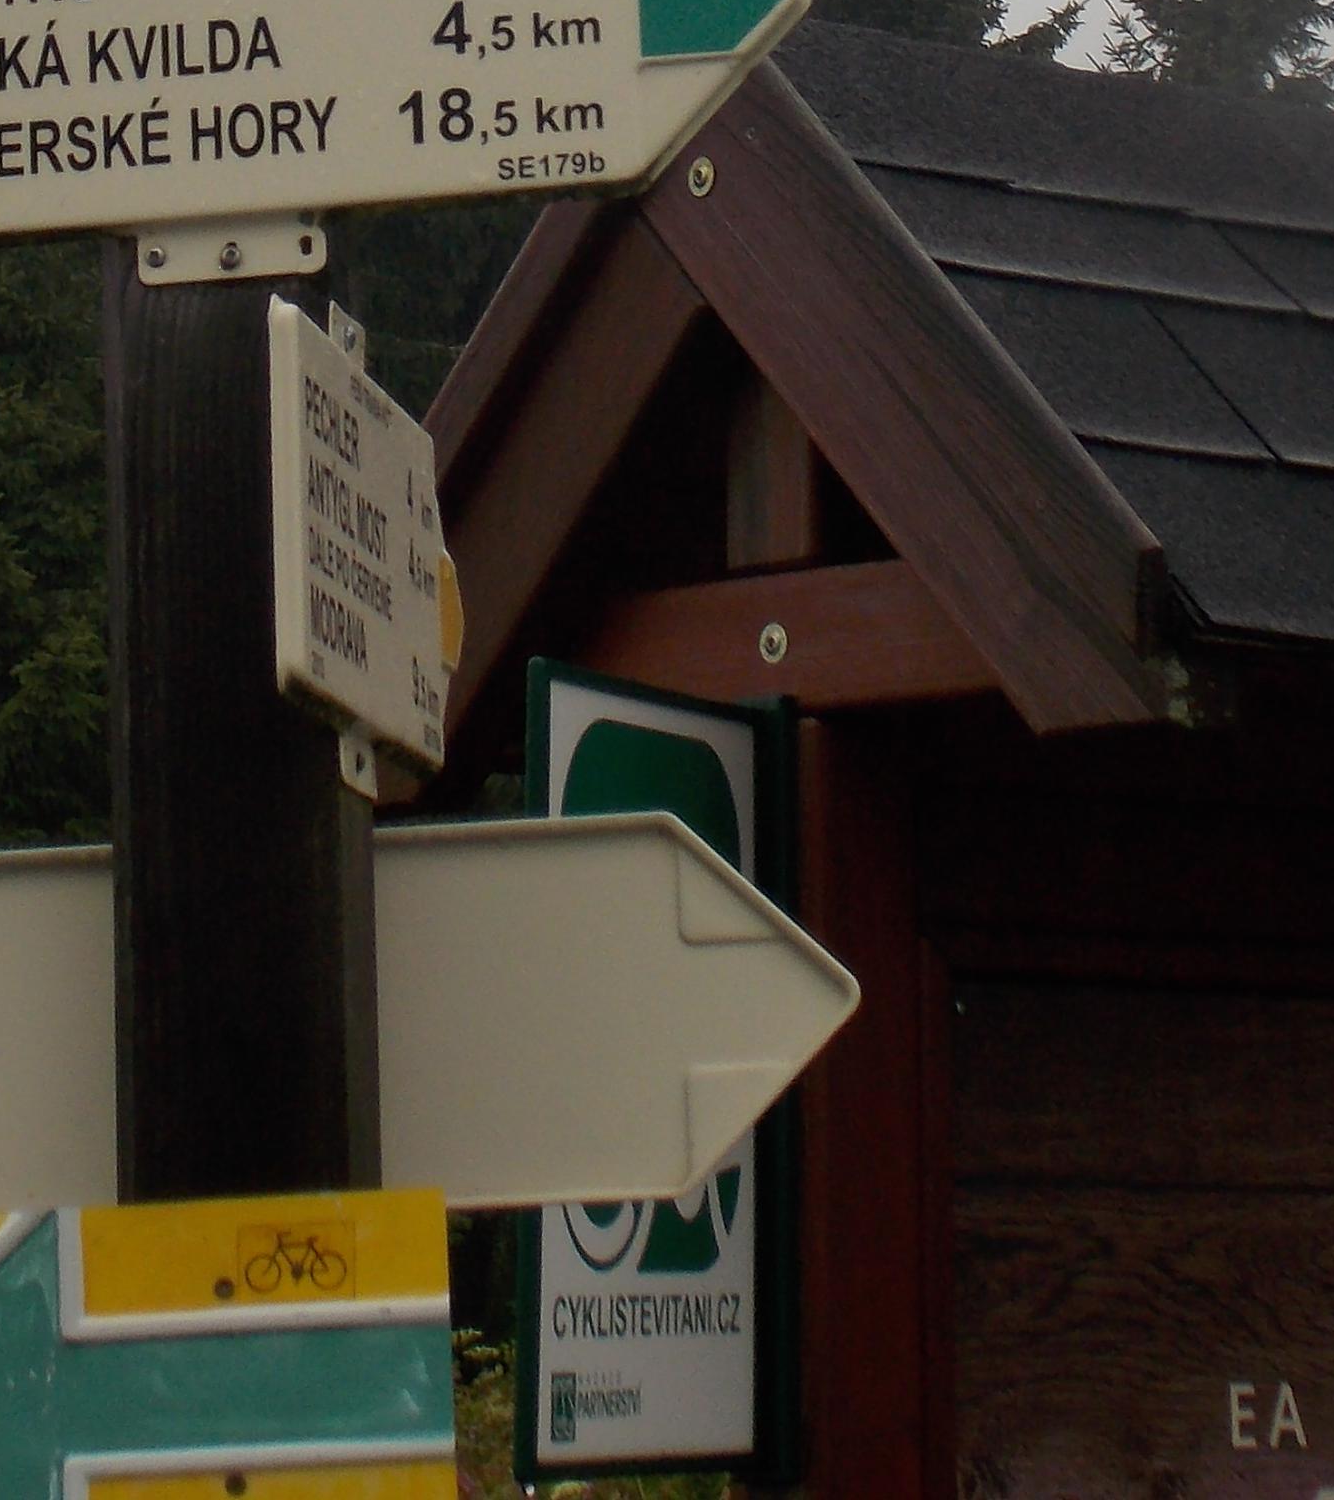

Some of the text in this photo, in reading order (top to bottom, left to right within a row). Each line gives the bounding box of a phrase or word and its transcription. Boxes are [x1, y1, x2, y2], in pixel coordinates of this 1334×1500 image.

[88, 17, 281, 83] KVILDA
[432, 1, 515, 59] 4,5
[533, 12, 600, 48] km
[191, 96, 337, 161] HORY
[399, 88, 517, 145] 18,5
[536, 98, 604, 133] km
[498, 151, 605, 180] SE179b
[310, 581, 369, 673] MODRAVA
[552, 1293, 741, 1338] CYKLISTEVITANI.CZ
[1228, 1379, 1308, 1450] EA
